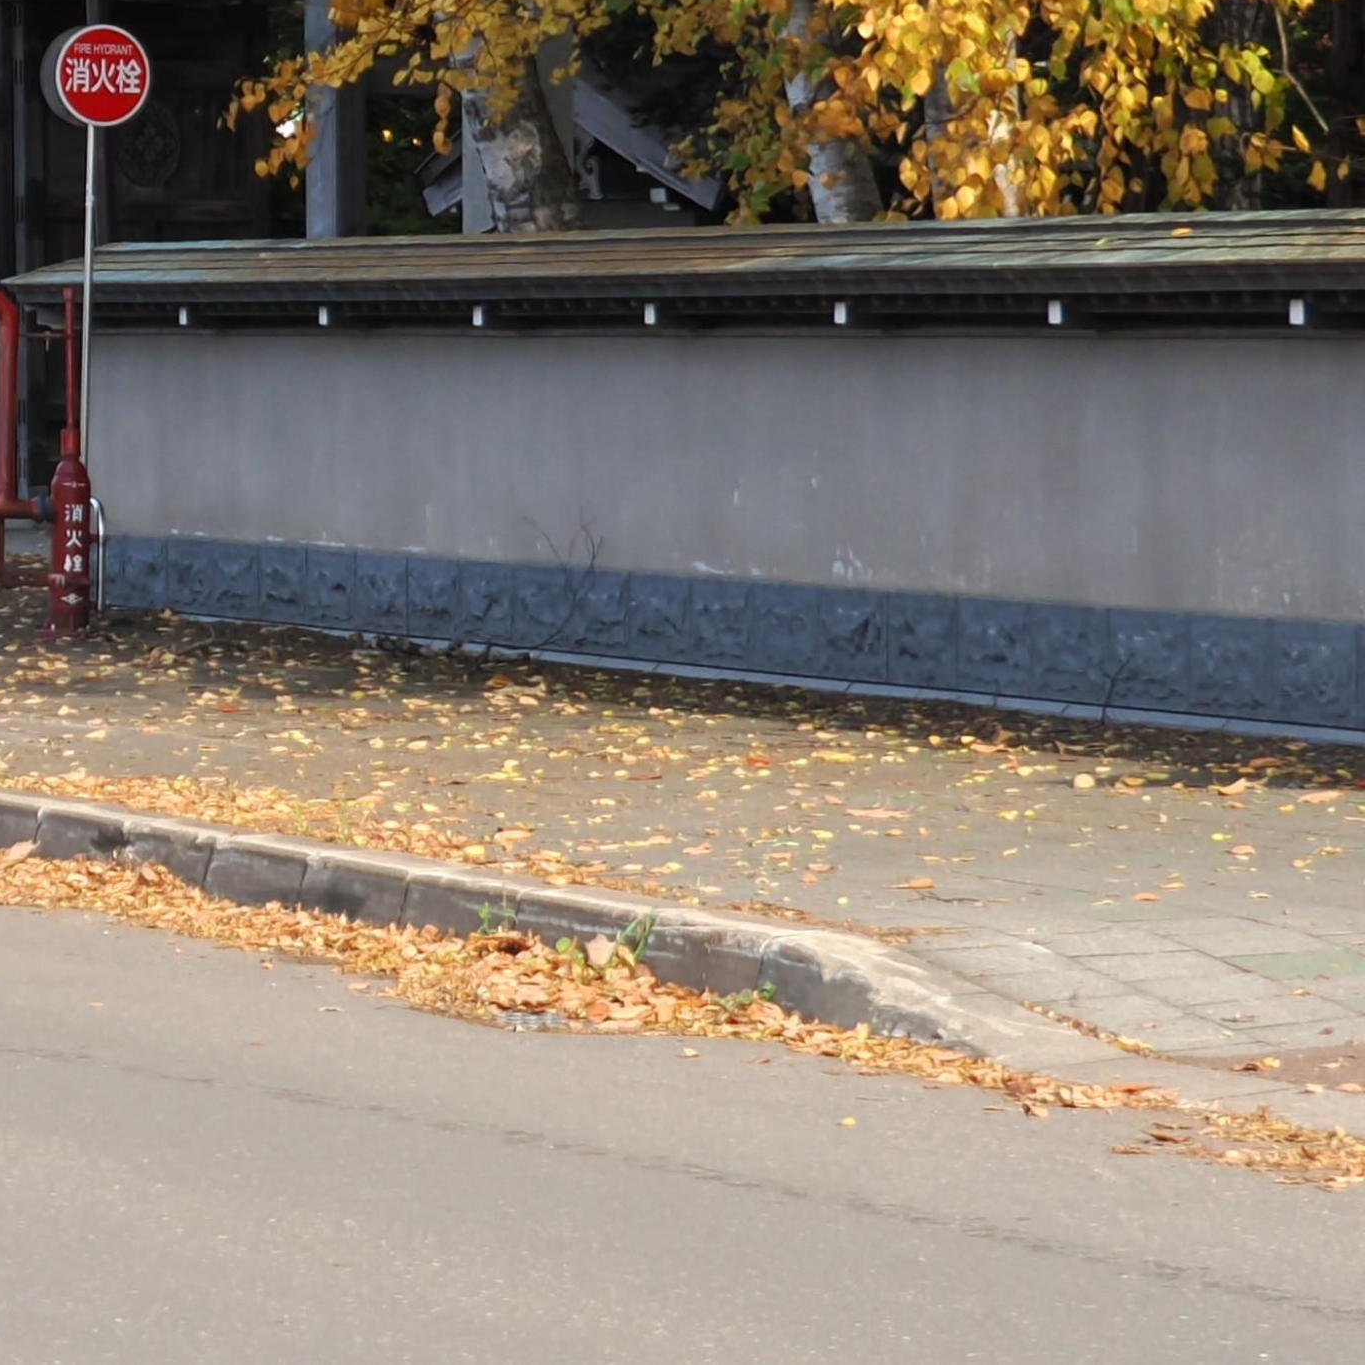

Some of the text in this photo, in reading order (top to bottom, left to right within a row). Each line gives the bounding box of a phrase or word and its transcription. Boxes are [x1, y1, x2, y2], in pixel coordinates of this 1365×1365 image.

[74, 43, 133, 55] FIRE HYDRANT
[65, 58, 141, 93] 消火栓
[64, 504, 83, 572] 消火栓
